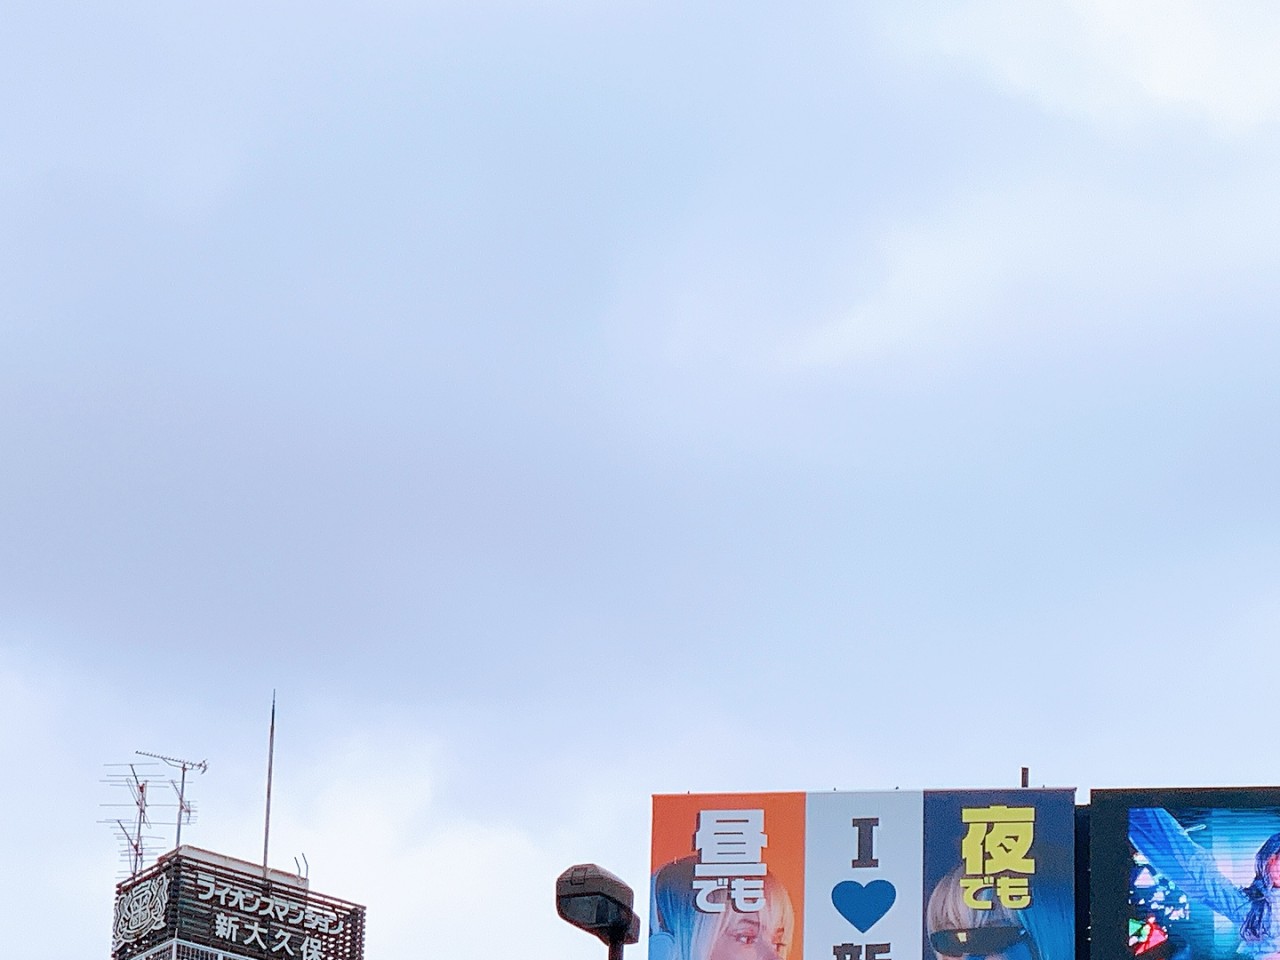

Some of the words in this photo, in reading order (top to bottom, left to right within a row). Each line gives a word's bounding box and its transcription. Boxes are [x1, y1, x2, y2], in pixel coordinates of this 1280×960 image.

[691, 808, 768, 877] 昼
[852, 817, 879, 868] I
[961, 805, 1035, 876] 夜
[692, 878, 766, 913] でも
[959, 876, 1032, 910] でも
